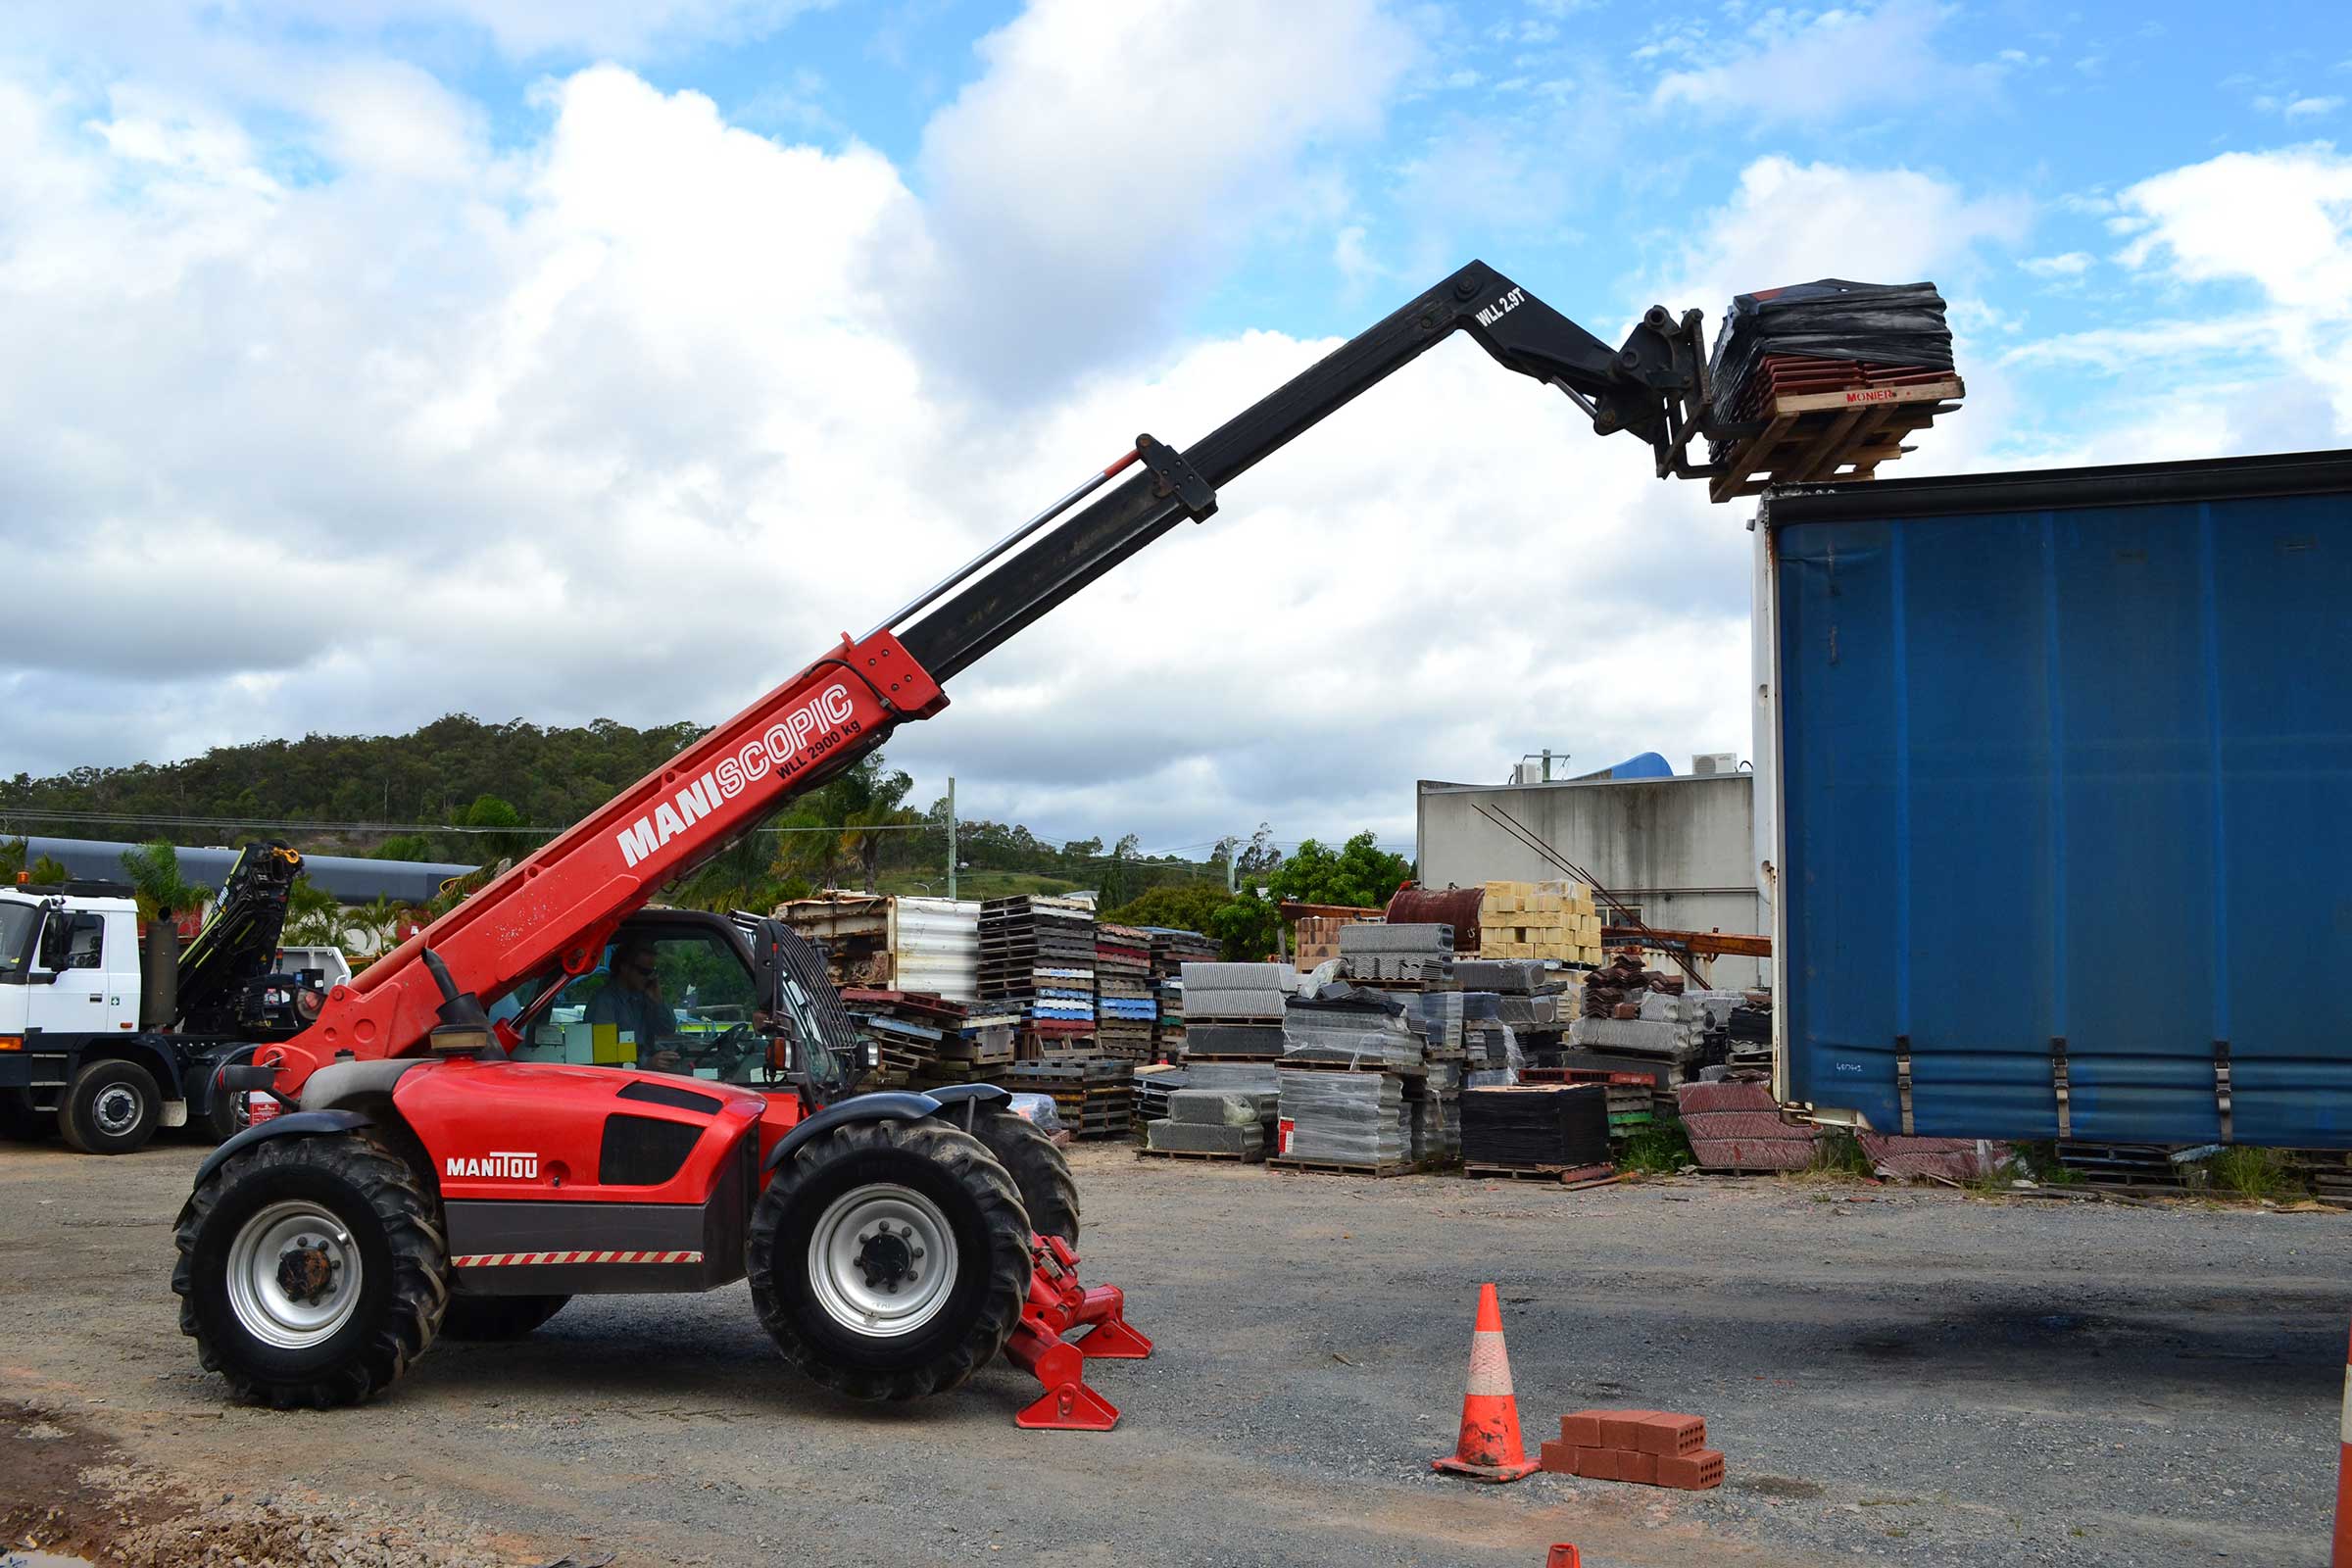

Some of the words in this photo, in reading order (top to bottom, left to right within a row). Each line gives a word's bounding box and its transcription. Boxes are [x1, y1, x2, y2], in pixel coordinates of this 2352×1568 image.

[1475, 304, 1504, 327] WLL
[1498, 287, 1525, 313] 2.9T
[1846, 389, 1892, 403] MONIER
[776, 756, 808, 779] WLL
[808, 731, 841, 760] 2900
[841, 720, 861, 736] kg
[616, 684, 854, 868] MANISCOPIC
[447, 1152, 537, 1178] MANITOU
